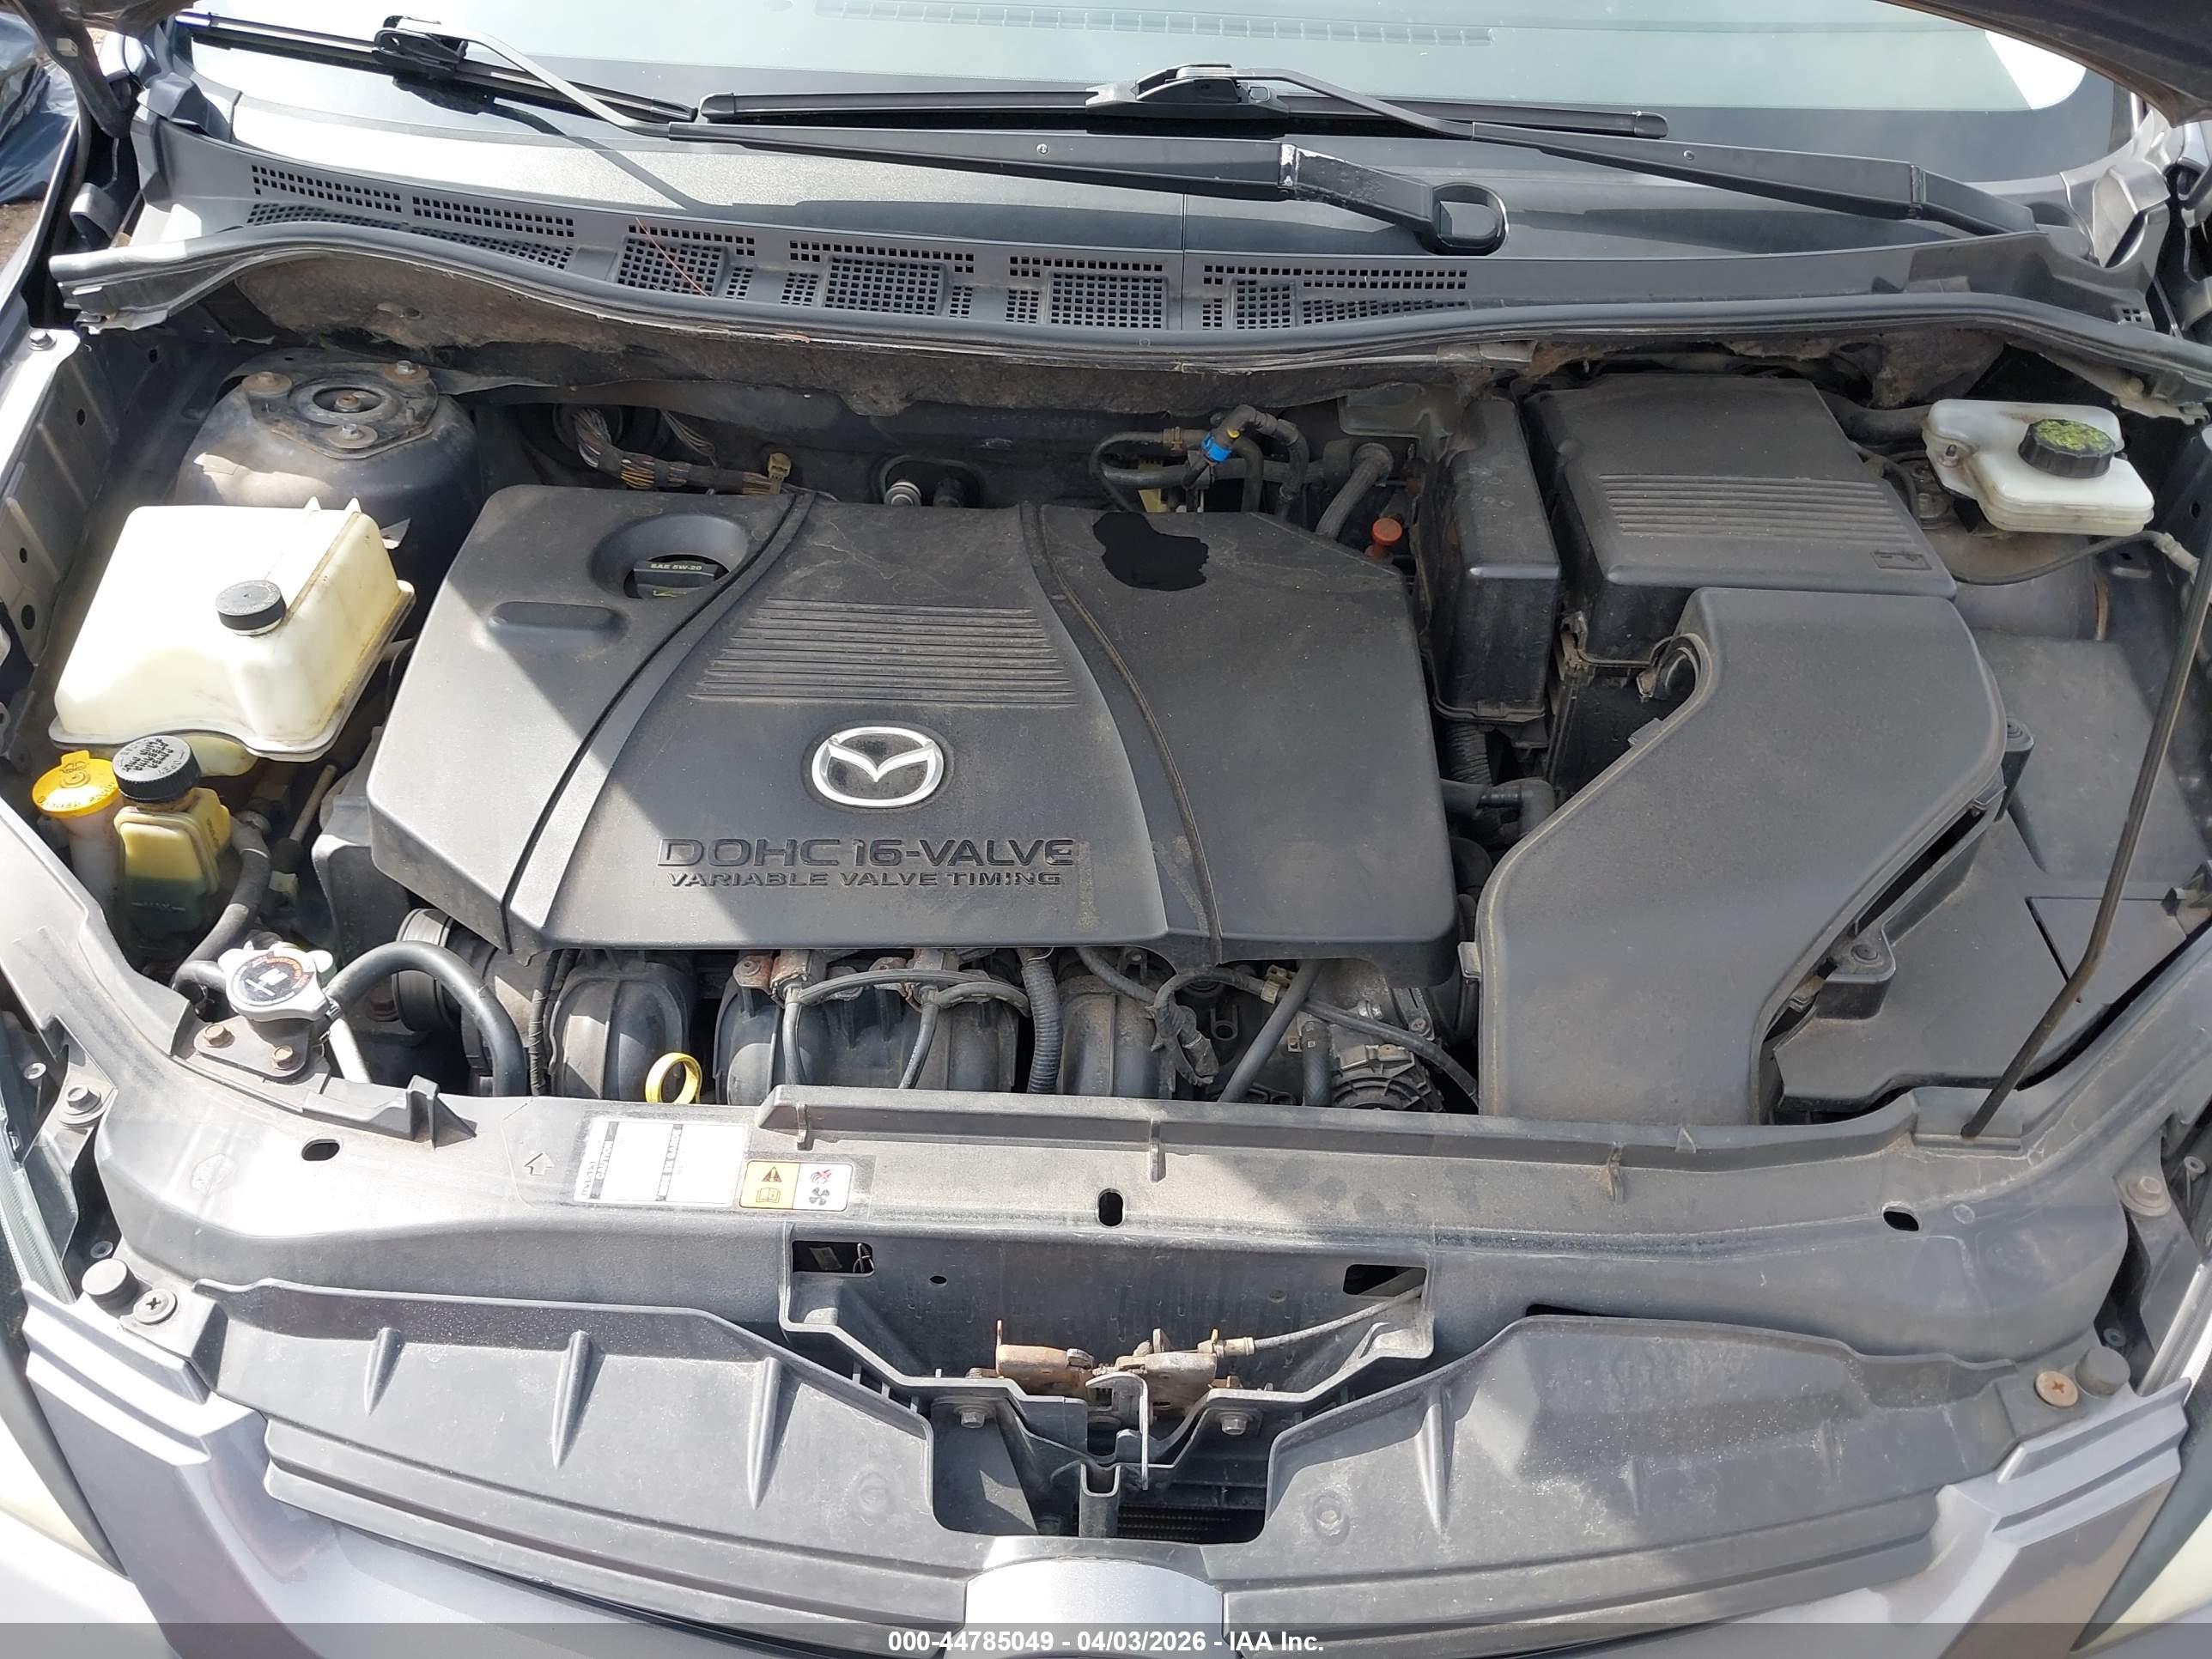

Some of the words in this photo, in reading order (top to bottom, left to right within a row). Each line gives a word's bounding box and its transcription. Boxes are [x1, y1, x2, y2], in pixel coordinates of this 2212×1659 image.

[657, 838, 841, 866] DOHC
[852, 838, 1075, 866] 16-VALVE
[666, 872, 829, 887] VARIABLE
[840, 872, 939, 887] VALVE
[946, 872, 1062, 887] TIMING
[595, 1140, 614, 1181] CAUTION
